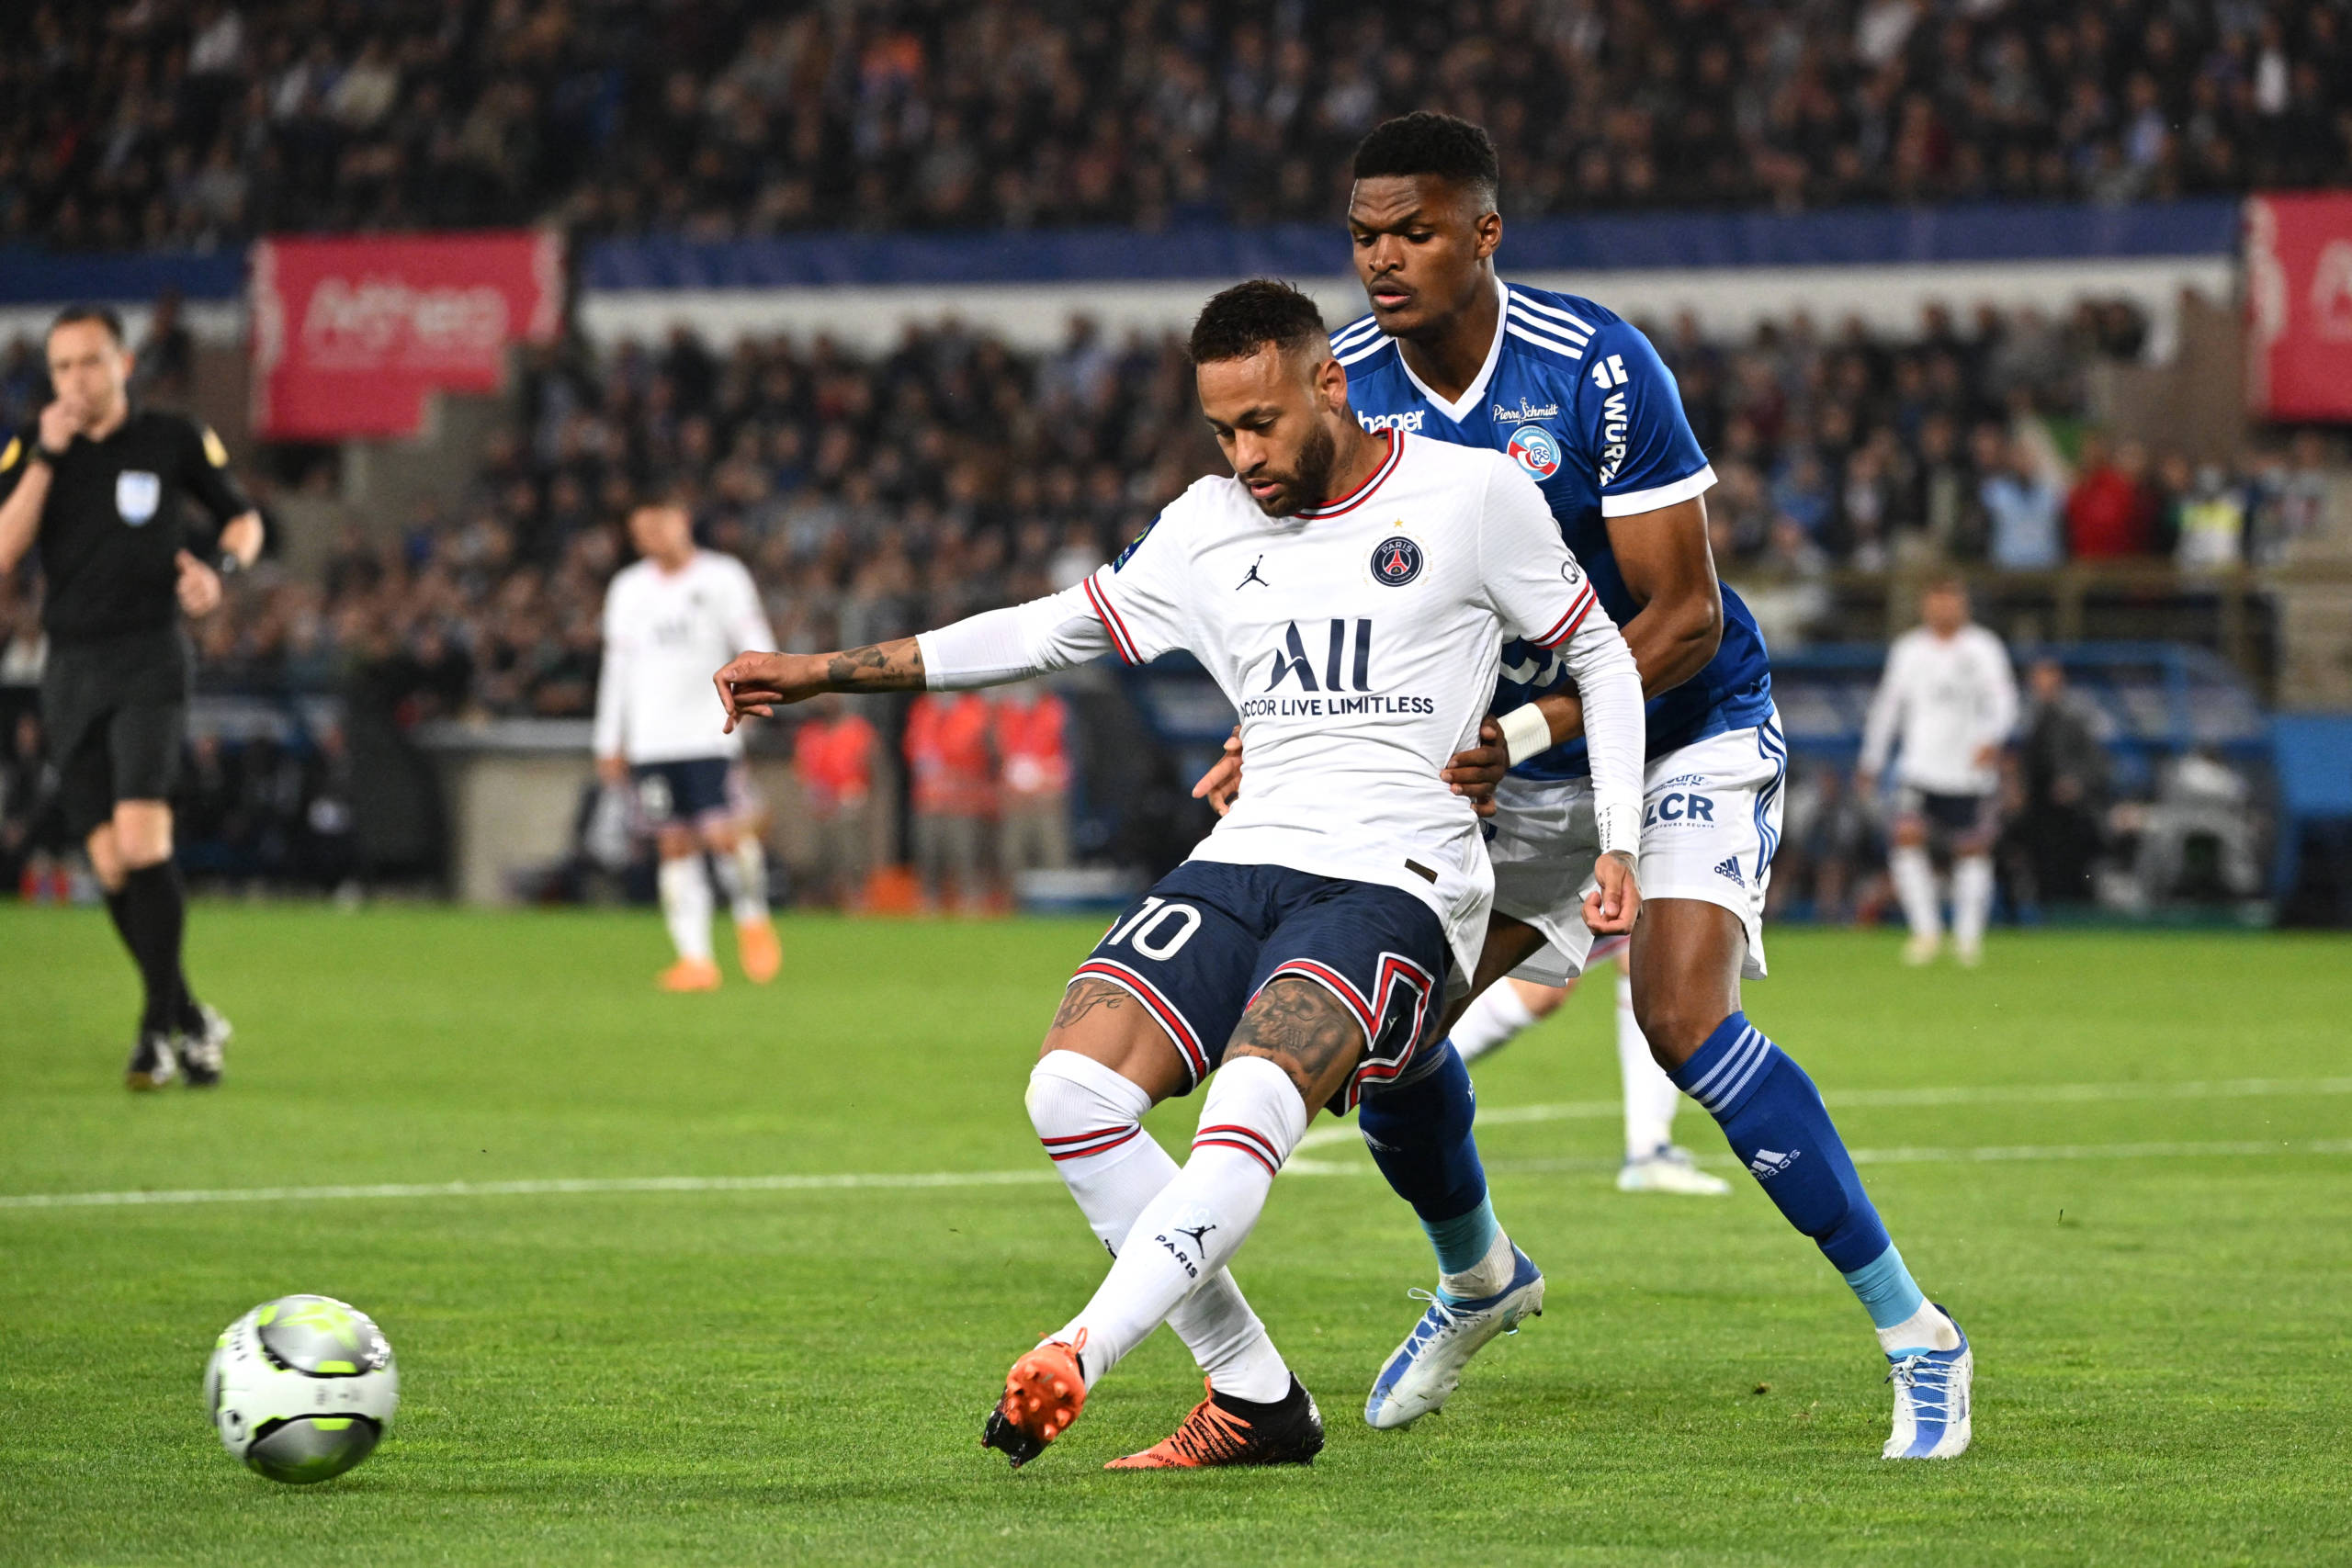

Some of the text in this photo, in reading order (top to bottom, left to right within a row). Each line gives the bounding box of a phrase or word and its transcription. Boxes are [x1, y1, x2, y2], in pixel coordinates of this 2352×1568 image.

[1357, 410, 1425, 434] hager
[1492, 399, 1559, 422] Pierre Schmidt
[1381, 541, 1413, 554] PARIS
[1282, 699, 1322, 716] LIVE
[1329, 696, 1434, 715] LIMITLESS
[1714, 865, 1745, 889] adidas
[1107, 897, 1202, 961] 10
[1756, 1149, 1801, 1179] didas
[1155, 1235, 1198, 1278] PARIS
